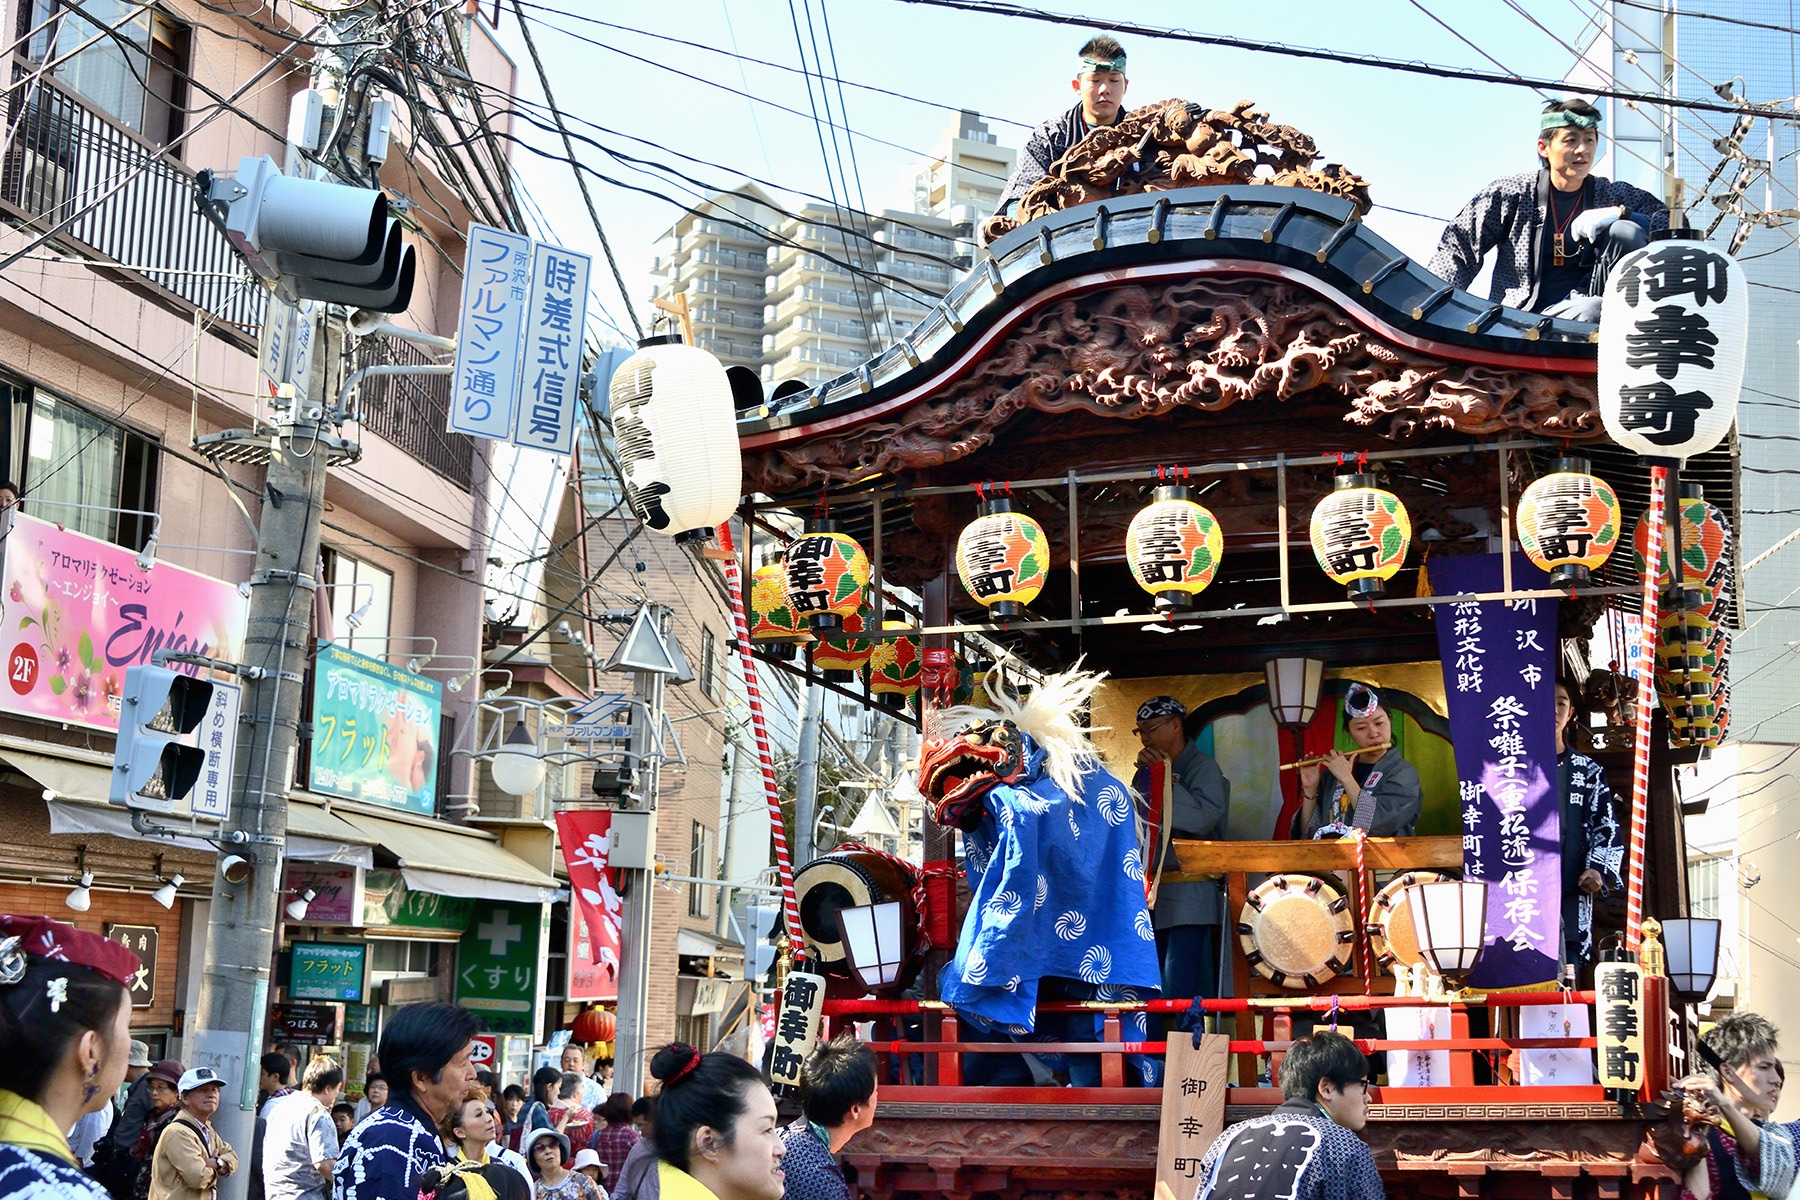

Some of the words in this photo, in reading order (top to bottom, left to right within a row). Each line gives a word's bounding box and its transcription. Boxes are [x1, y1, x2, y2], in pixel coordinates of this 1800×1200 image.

[510, 251, 528, 300] 所沢市
[463, 239, 510, 422] ファルマン通り
[528, 255, 577, 444] 時差式信号
[1616, 246, 1730, 446] 御幸町
[1320, 493, 1379, 576] 御幸町
[1534, 478, 1594, 561] 御幸町
[51, 550, 152, 595] アロマリラクゼーション
[783, 536, 834, 612] 御幸町
[12, 655, 36, 683] 2F
[1450, 591, 1486, 693] 無形文化財
[1513, 589, 1545, 690] 所沢市
[327, 670, 433, 726] アロマリラクゼーション
[566, 726, 632, 737] ファルマン通り
[204, 690, 229, 808] 斜め横断専用
[317, 713, 391, 772] フラット
[303, 960, 353, 976] フラット
[462, 964, 531, 992] くすり
[287, 1019, 319, 1030] つぼみ
[773, 977, 818, 1081] 御幸町
[1601, 968, 1639, 1082] 御幸町
[1173, 1077, 1207, 1178] 御幸町
